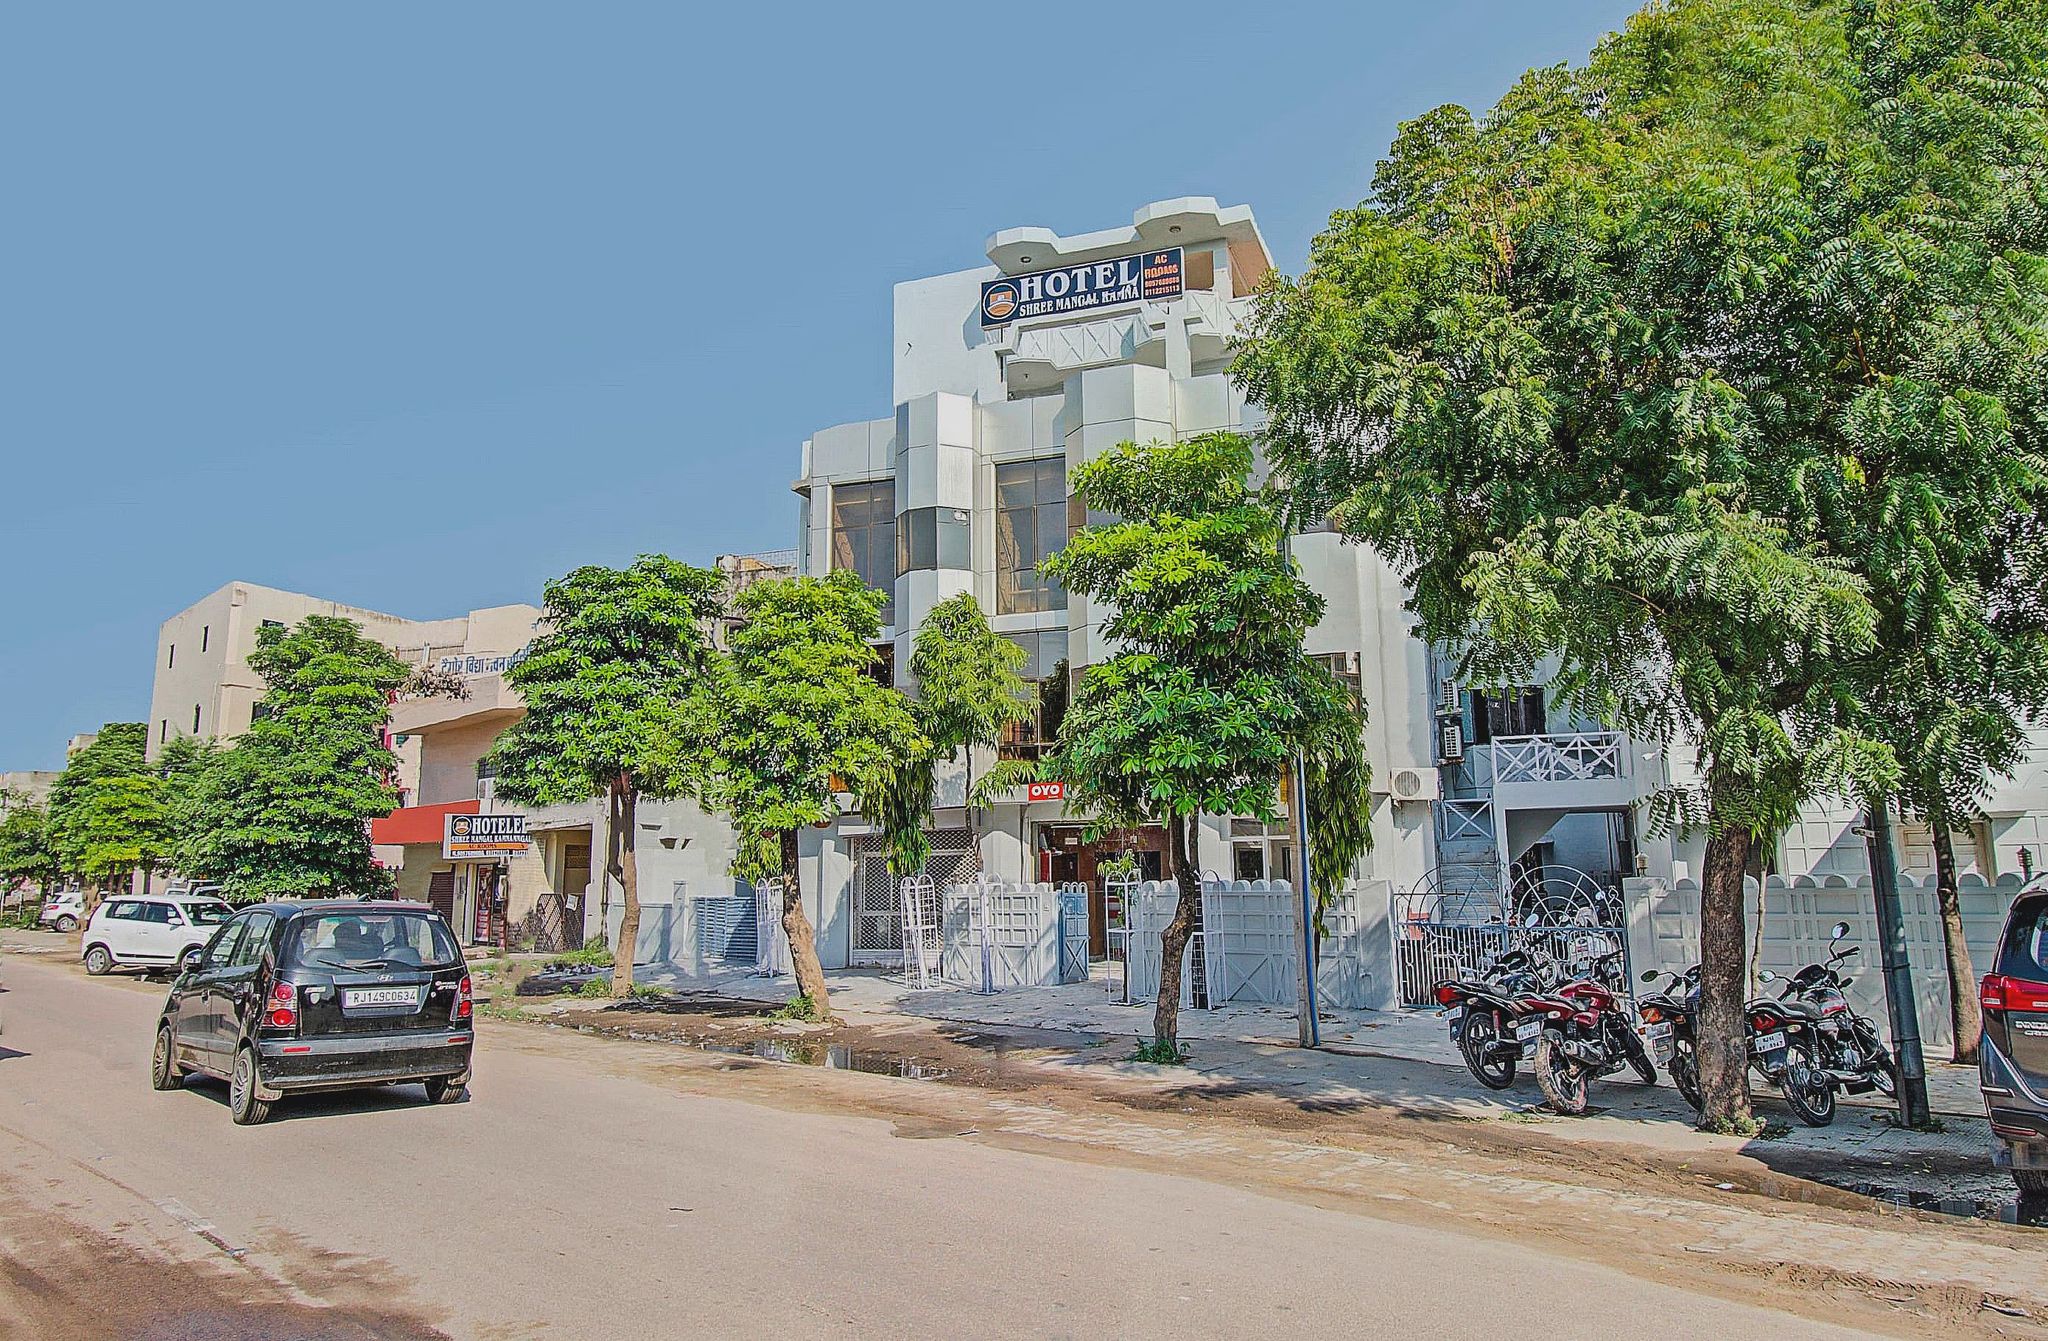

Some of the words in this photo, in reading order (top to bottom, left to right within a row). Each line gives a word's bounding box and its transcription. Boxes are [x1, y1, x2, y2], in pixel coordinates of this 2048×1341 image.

[1154, 254, 1168, 265] AC
[1019, 260, 1140, 303] HOTEL
[1019, 300, 1054, 317] SHREE
[1056, 292, 1099, 311] MANGAL
[1102, 285, 1140, 304] KAMNA
[1031, 785, 1060, 796] OYO
